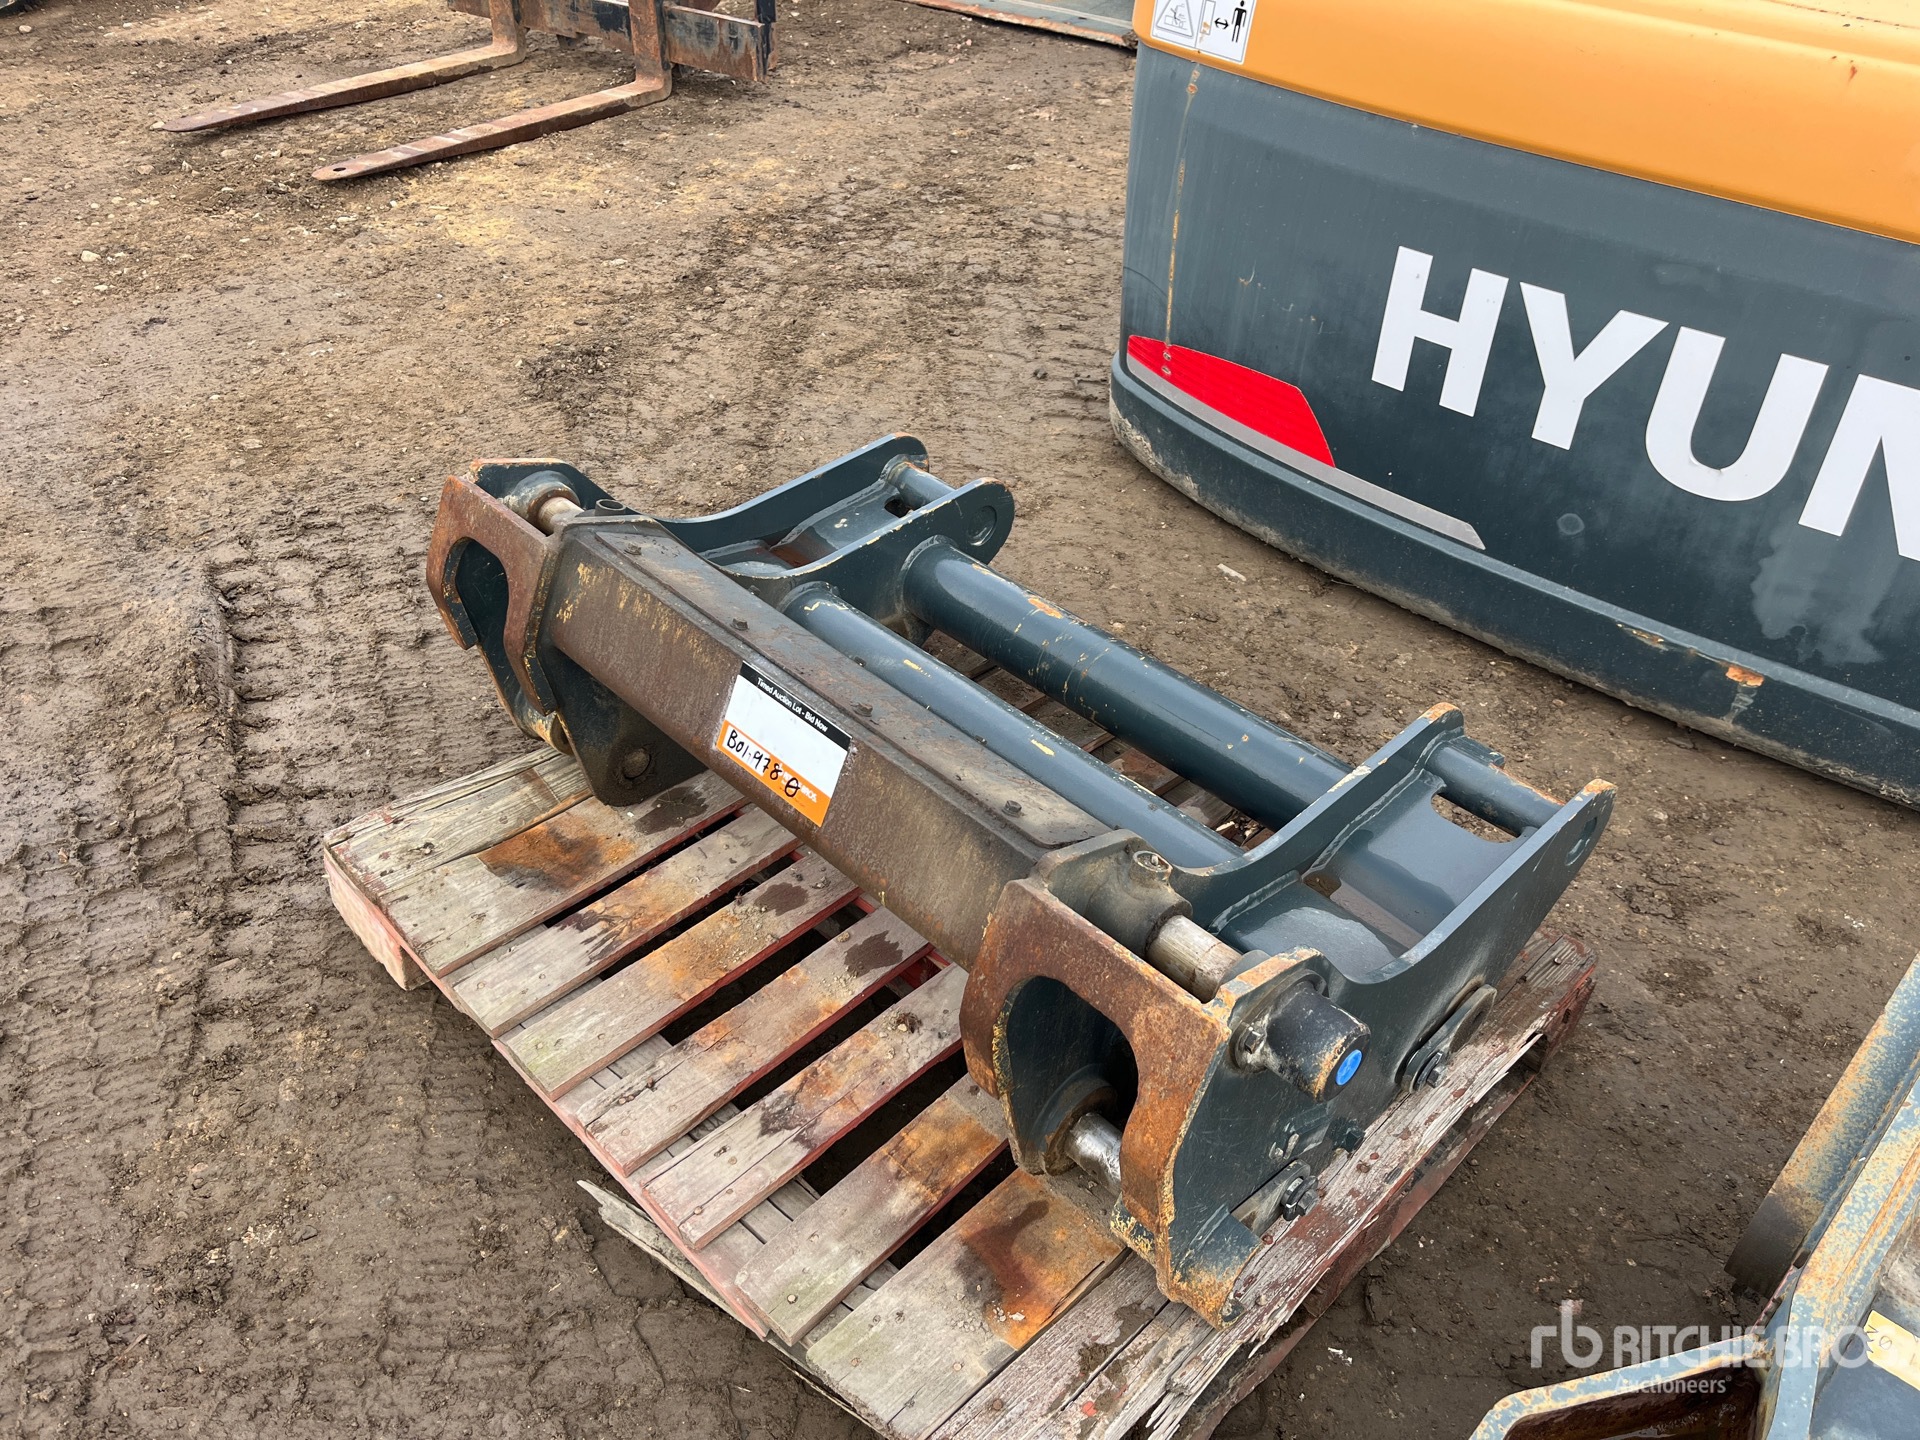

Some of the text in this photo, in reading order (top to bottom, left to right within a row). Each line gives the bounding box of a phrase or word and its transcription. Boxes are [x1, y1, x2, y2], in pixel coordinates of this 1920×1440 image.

[757, 677, 774, 694] Timed
[773, 689, 793, 708] Auction
[792, 702, 802, 714] Lot
[804, 711, 816, 723] Bid
[814, 718, 828, 732] Now
